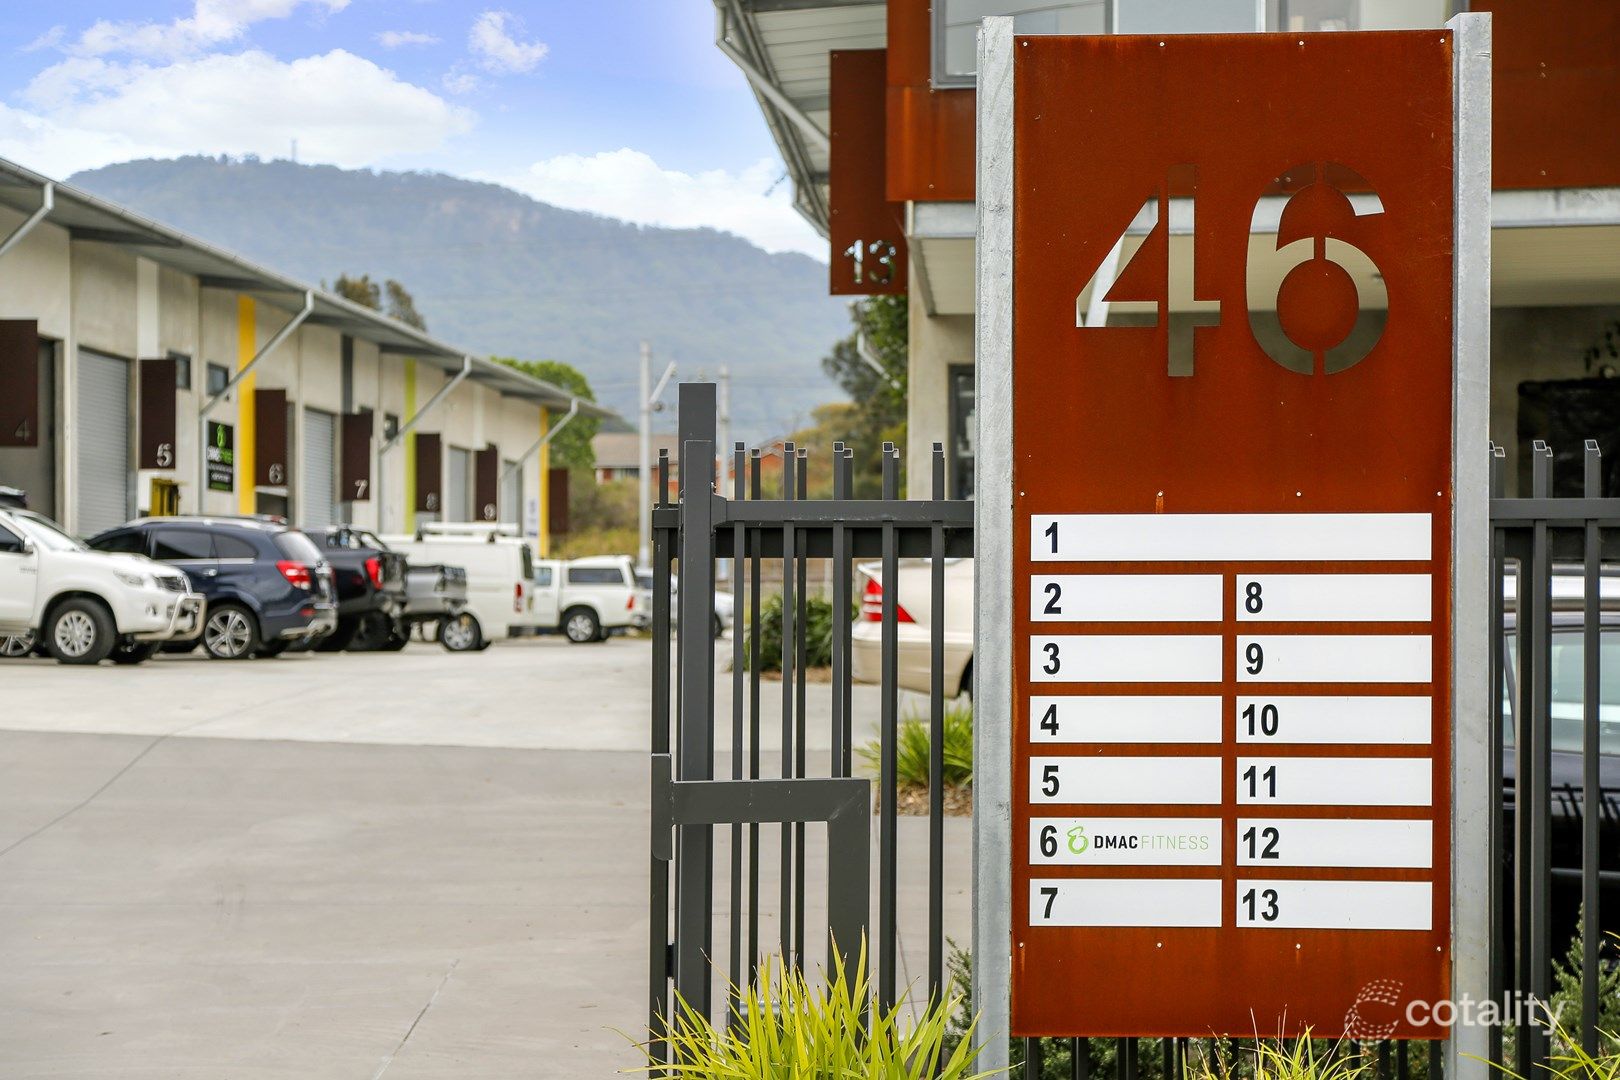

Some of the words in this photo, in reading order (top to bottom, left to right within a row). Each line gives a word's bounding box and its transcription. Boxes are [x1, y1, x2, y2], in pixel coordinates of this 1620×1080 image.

[843, 239, 897, 286] 13
[1076, 162, 1389, 377] 46
[14, 416, 31, 441] 4
[156, 442, 173, 467] 5
[268, 463, 285, 485] 6
[354, 478, 369, 499] 7
[1045, 522, 1059, 554] 1
[1044, 583, 1062, 615] 2
[1245, 582, 1263, 614] 8
[1043, 643, 1061, 675] 3
[1245, 643, 1264, 675] 9
[1041, 704, 1060, 737] 4
[1242, 704, 1279, 737] 10
[1042, 766, 1060, 798] 5
[1243, 766, 1277, 798] 11
[1040, 826, 1058, 858] 6
[1243, 827, 1280, 860] 12
[1040, 888, 1059, 920] 7
[1243, 889, 1280, 922] 13
